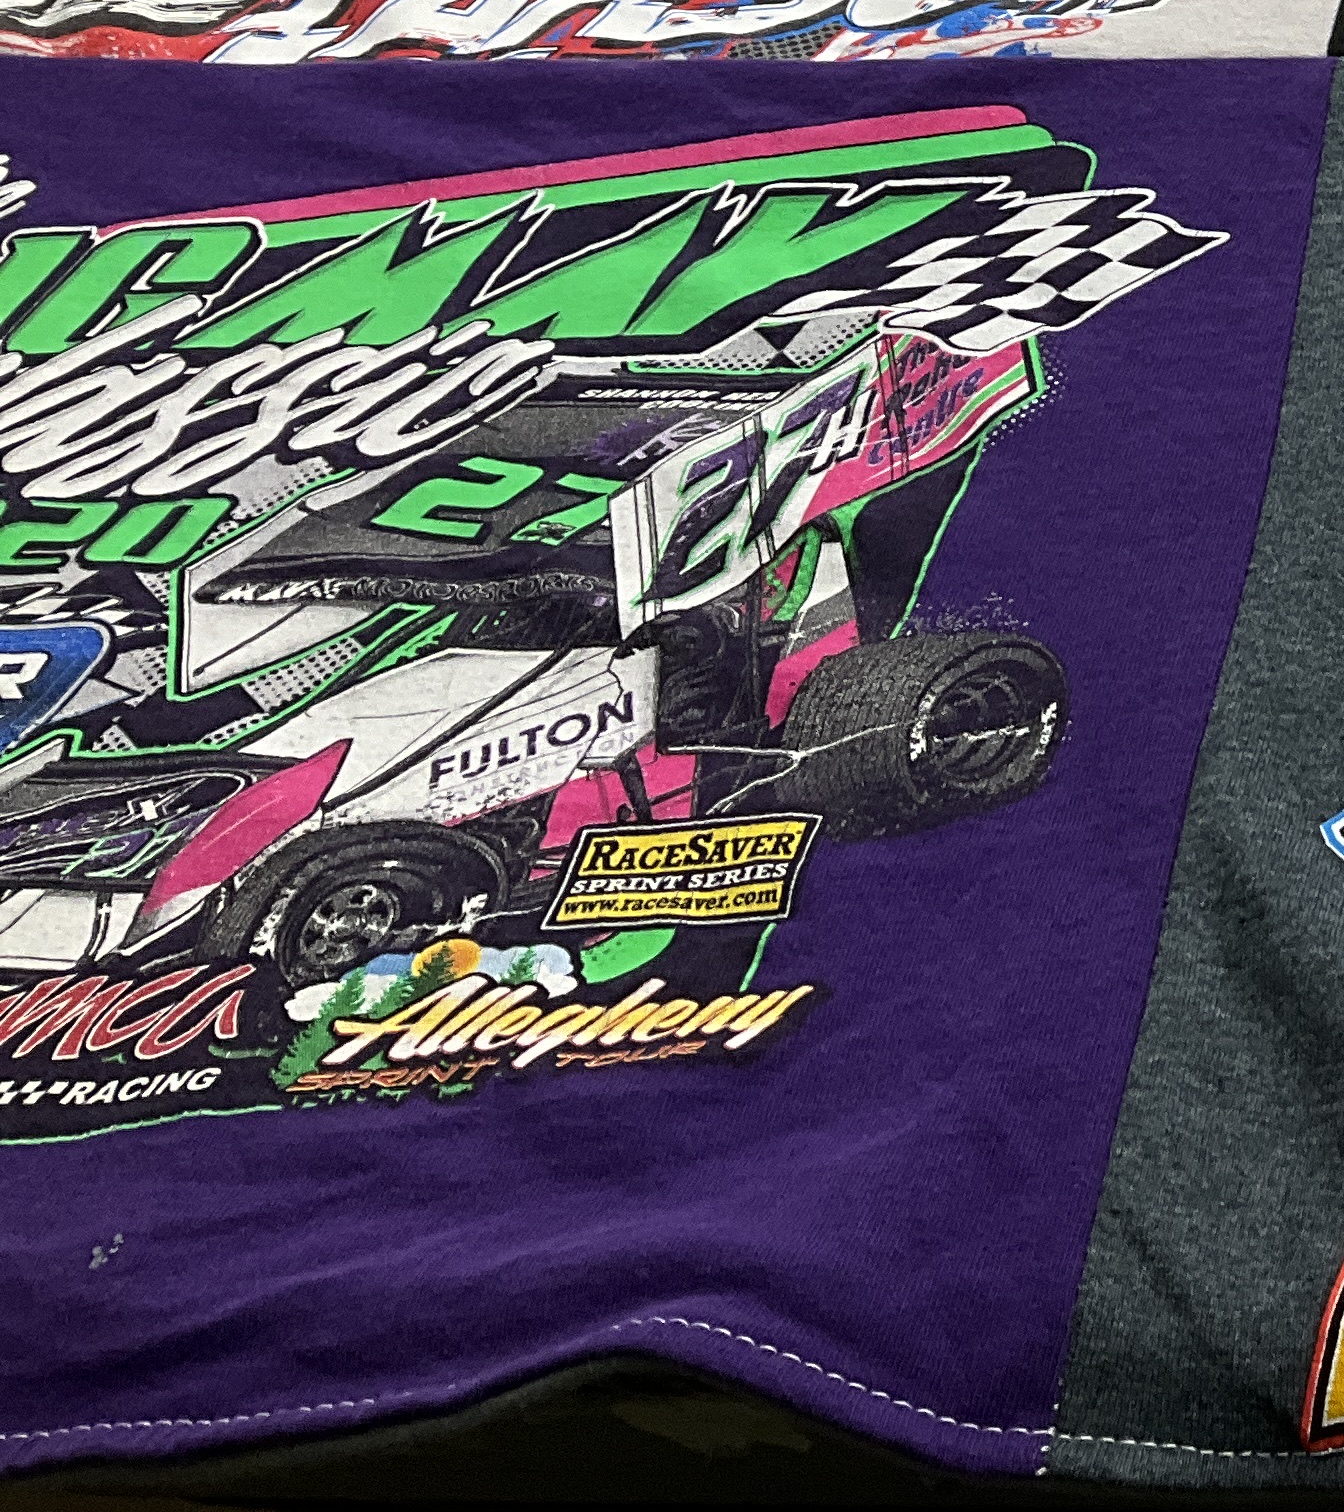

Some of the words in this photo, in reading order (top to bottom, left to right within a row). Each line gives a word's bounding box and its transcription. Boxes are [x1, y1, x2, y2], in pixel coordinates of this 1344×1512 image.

[427, 696, 636, 790] FULTON
[570, 874, 684, 896] SPRINT
[687, 862, 789, 890] SERIES
[562, 887, 780, 918] www.racesaver.com
[331, 978, 815, 1065] Allegheny
[556, 1040, 711, 1068] TOUR
[64, 1065, 221, 1107] RACING
